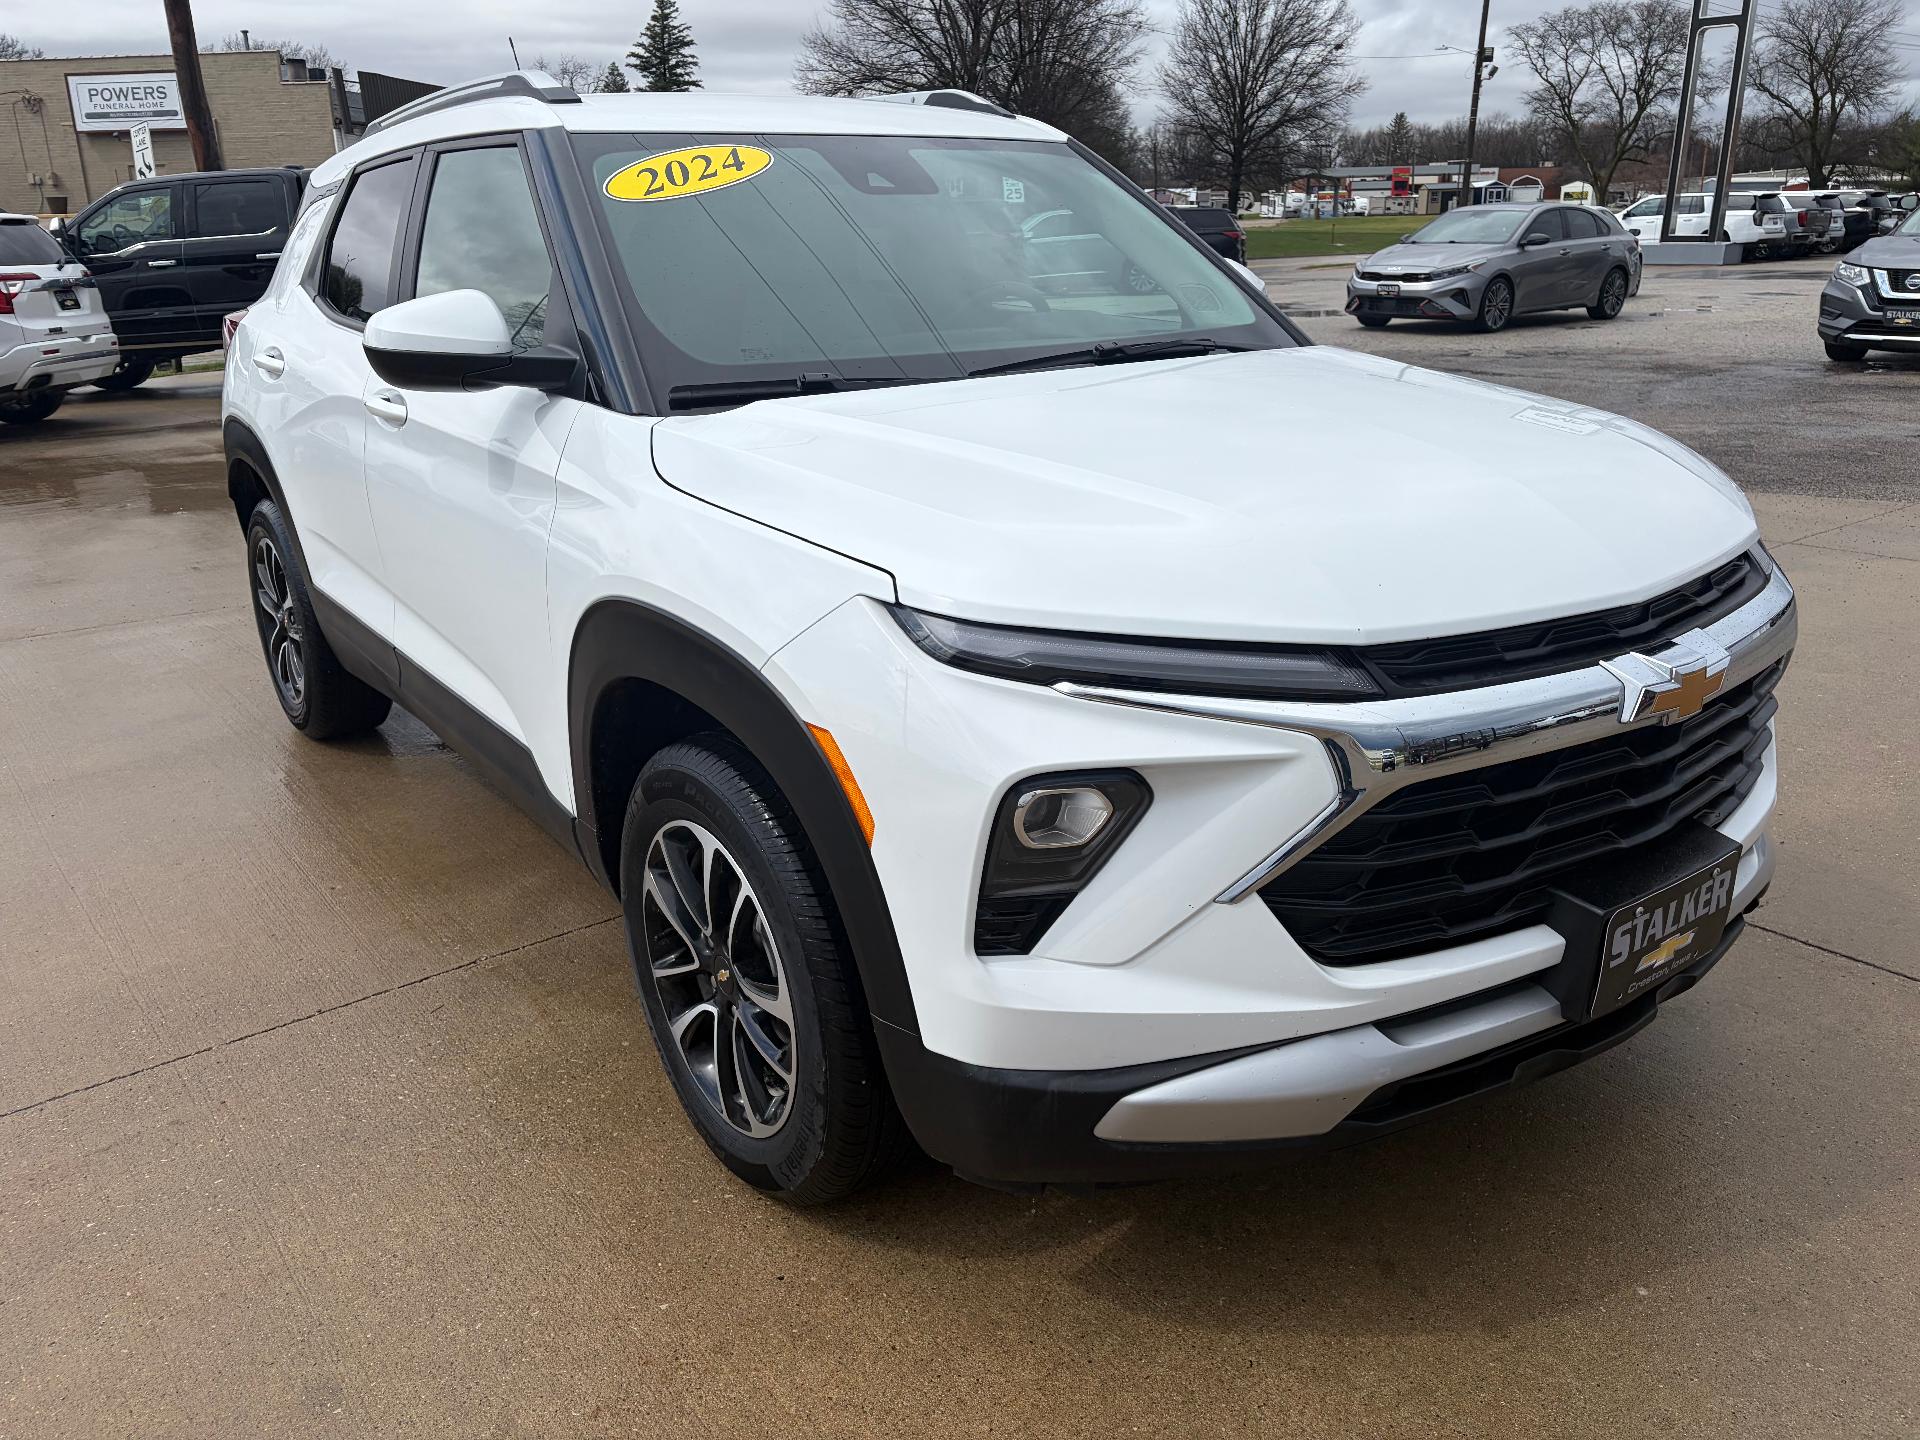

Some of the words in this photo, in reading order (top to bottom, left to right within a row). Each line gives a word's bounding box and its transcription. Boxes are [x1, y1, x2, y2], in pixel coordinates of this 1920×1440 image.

[88, 86, 167, 101] POWERS
[135, 137, 147, 148] LANE
[636, 147, 746, 196] 2024
[1006, 188, 1022, 199] 25
[1609, 870, 1732, 968] STALKER
[1627, 967, 1670, 994] Creston,
[1670, 952, 1692, 970] Iowa
